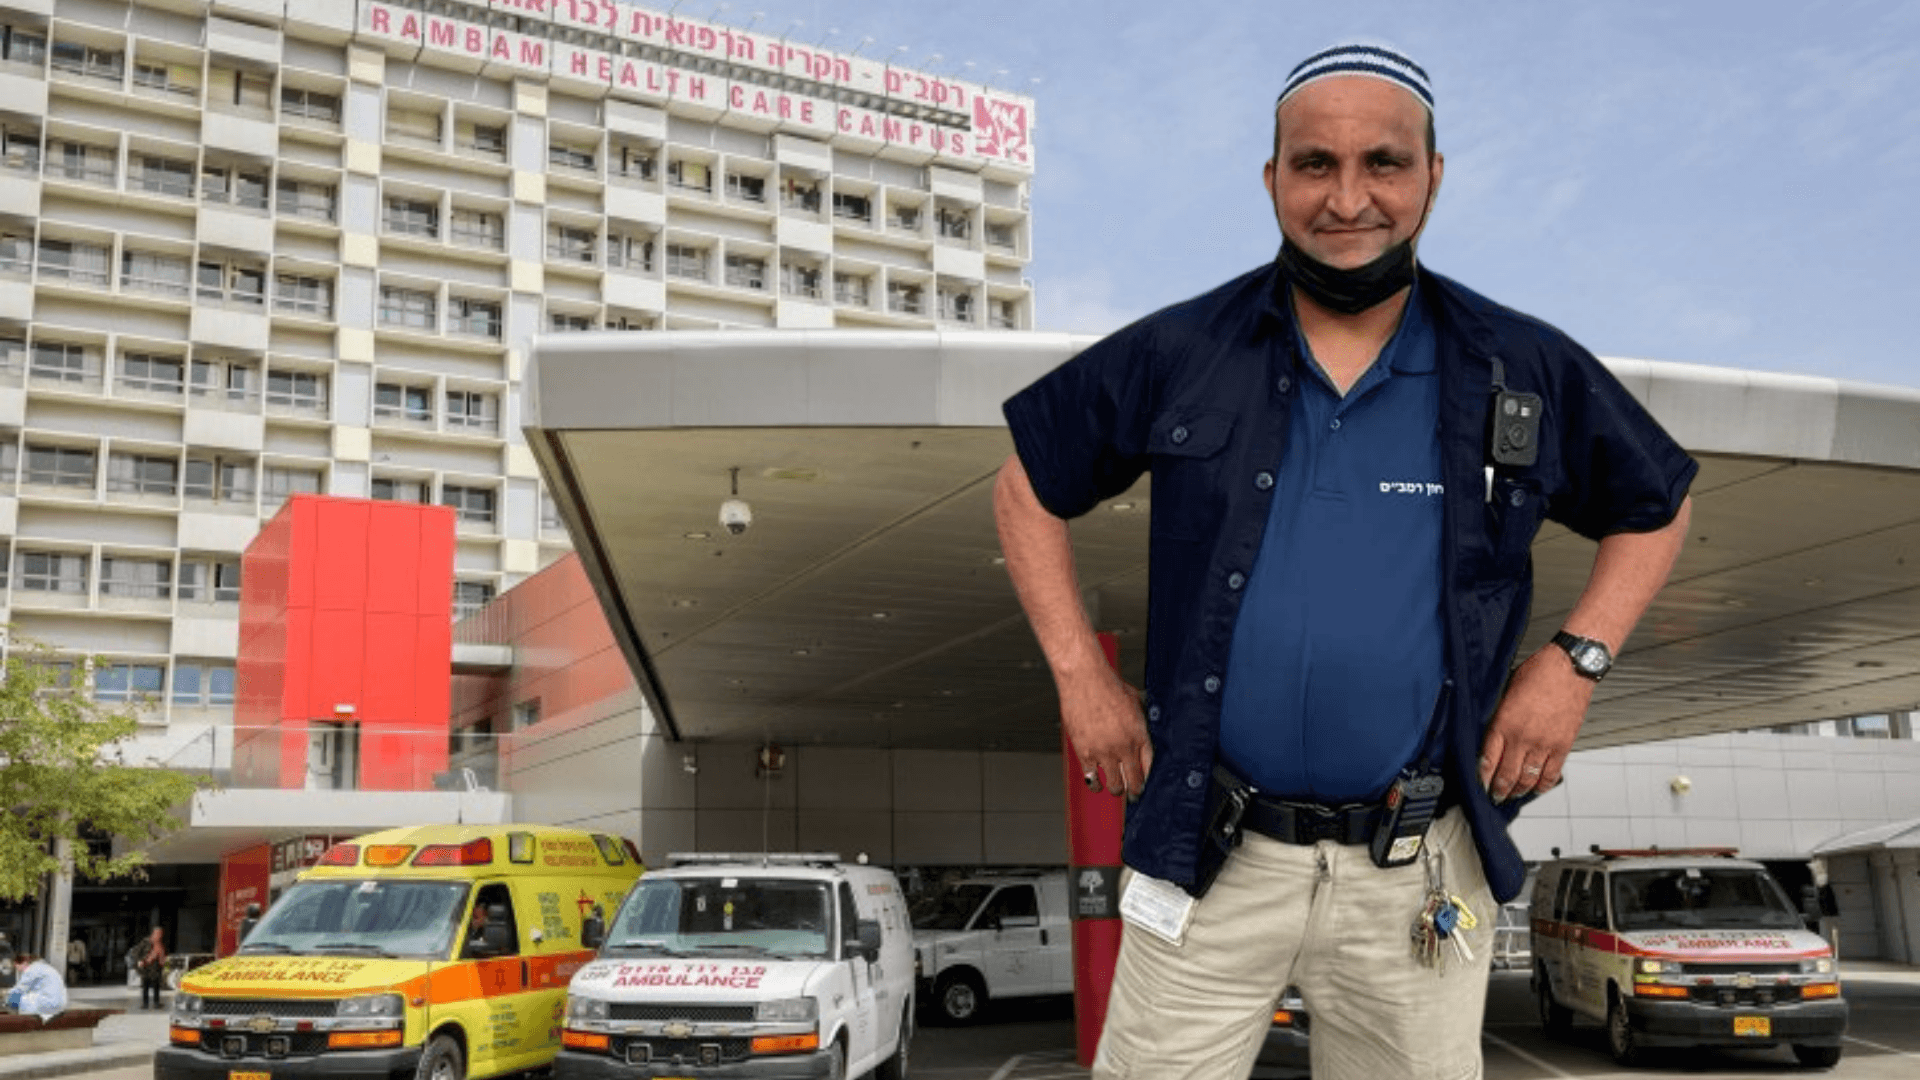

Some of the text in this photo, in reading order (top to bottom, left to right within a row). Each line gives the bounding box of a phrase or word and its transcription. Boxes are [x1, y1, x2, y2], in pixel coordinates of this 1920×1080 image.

[631, 12, 755, 60] הרפואית
[768, 43, 852, 82] הקריה
[371, 7, 965, 155] RAMBAM HEALTH CARE CAMPUS
[1425, 482, 1444, 496] חון
[216, 970, 351, 983] AMBULANCE
[613, 974, 761, 989] AMBULANCE
